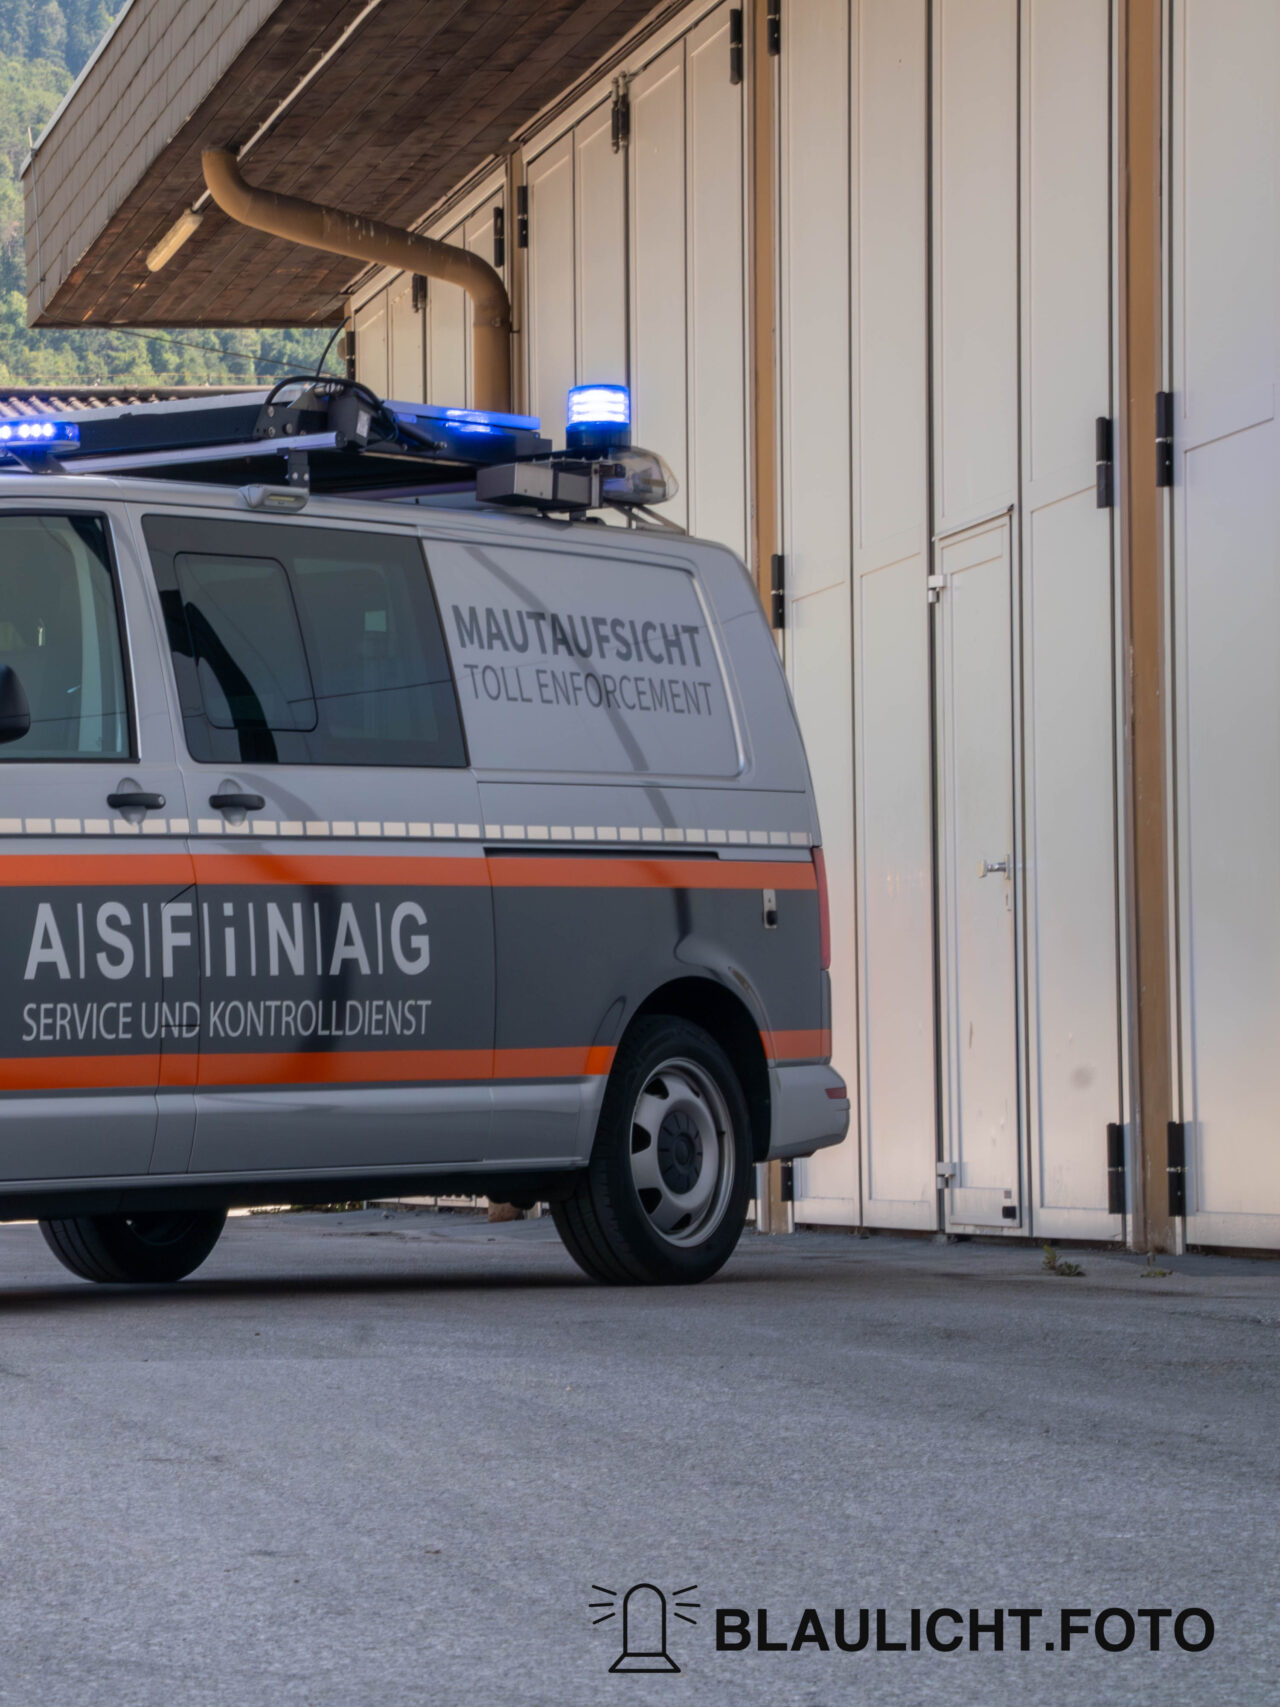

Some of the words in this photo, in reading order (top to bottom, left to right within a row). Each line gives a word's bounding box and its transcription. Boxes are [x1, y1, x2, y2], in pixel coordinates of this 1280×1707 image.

[452, 605, 701, 667] MAUTAUFSICHT
[464, 664, 532, 703] TOLL
[536, 669, 712, 716] ENFORCEMENT
[22, 1002, 133, 1041] SERVICE
[141, 1002, 201, 1039] UND
[209, 1000, 432, 1038] KONTROLLDIENST
